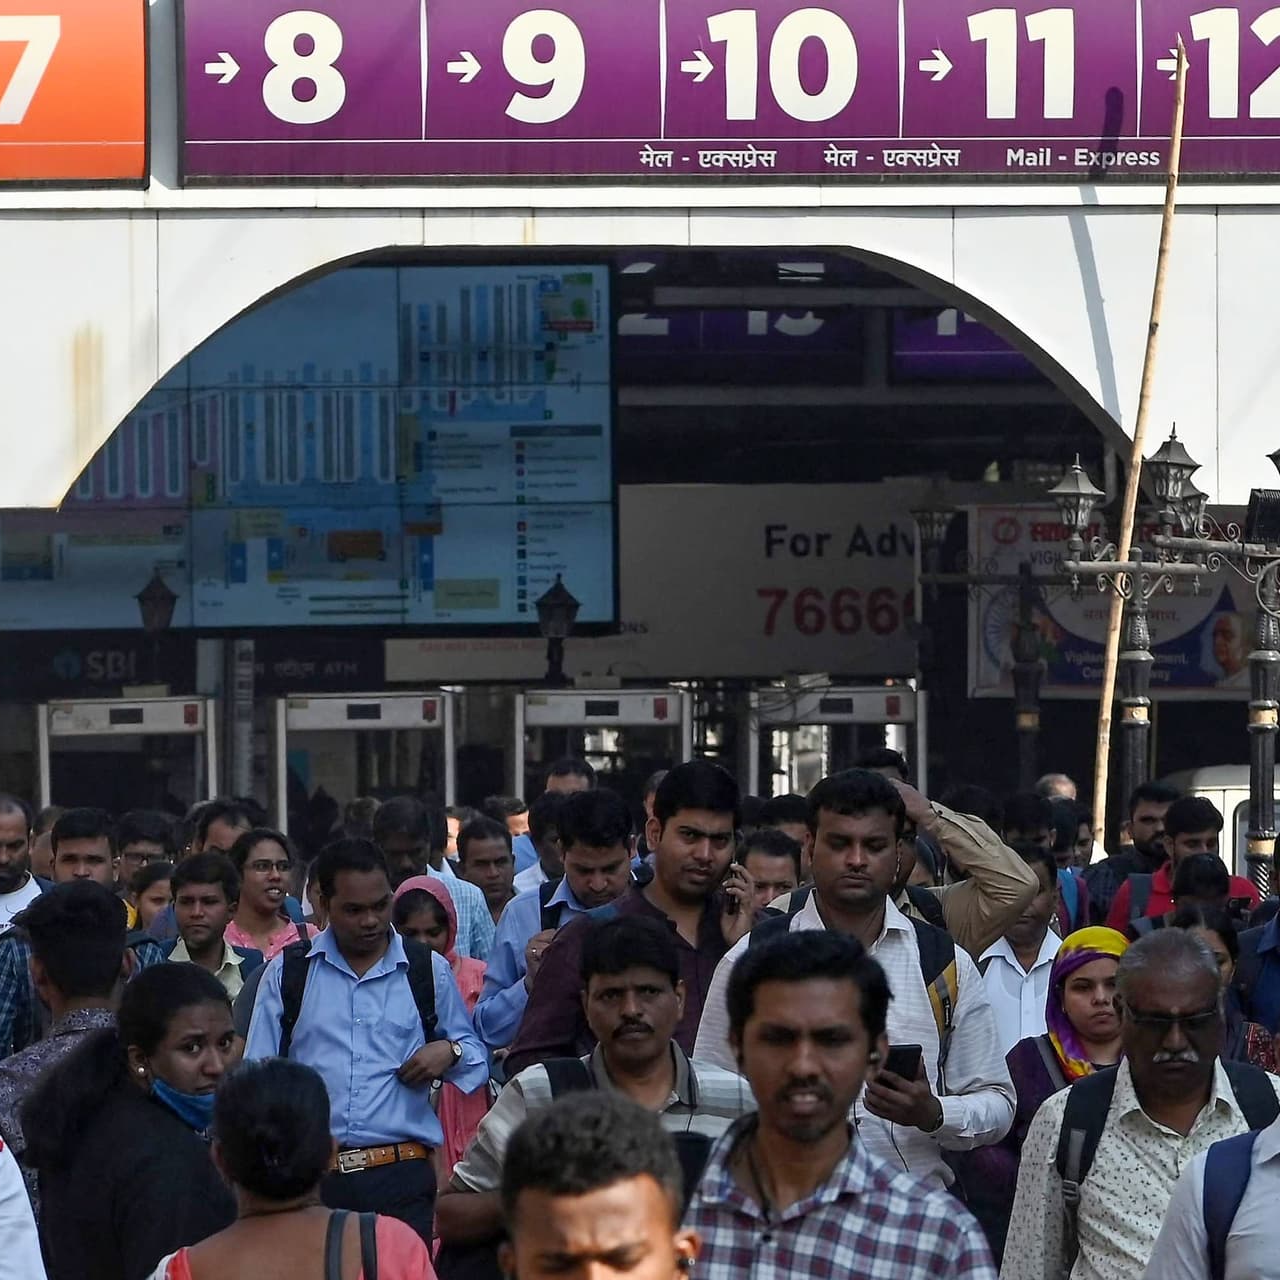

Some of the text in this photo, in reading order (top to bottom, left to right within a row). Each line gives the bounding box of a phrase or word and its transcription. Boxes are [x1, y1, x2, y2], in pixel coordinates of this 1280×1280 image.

[263, 11, 345, 124] 8
[503, 10, 585, 123] 9
[707, 8, 857, 121] 10
[967, 8, 1074, 119] 11
[639, 145, 673, 167] मेल
[698, 145, 777, 168] एक्सप्रेस
[824, 145, 858, 167] मेल
[883, 145, 961, 168] एक्सप्रेस
[1007, 148, 1050, 166] Mail
[1075, 149, 1160, 168] Express
[765, 525, 831, 557] For
[757, 586, 914, 636] 7666
[86, 652, 136, 680] SBI
